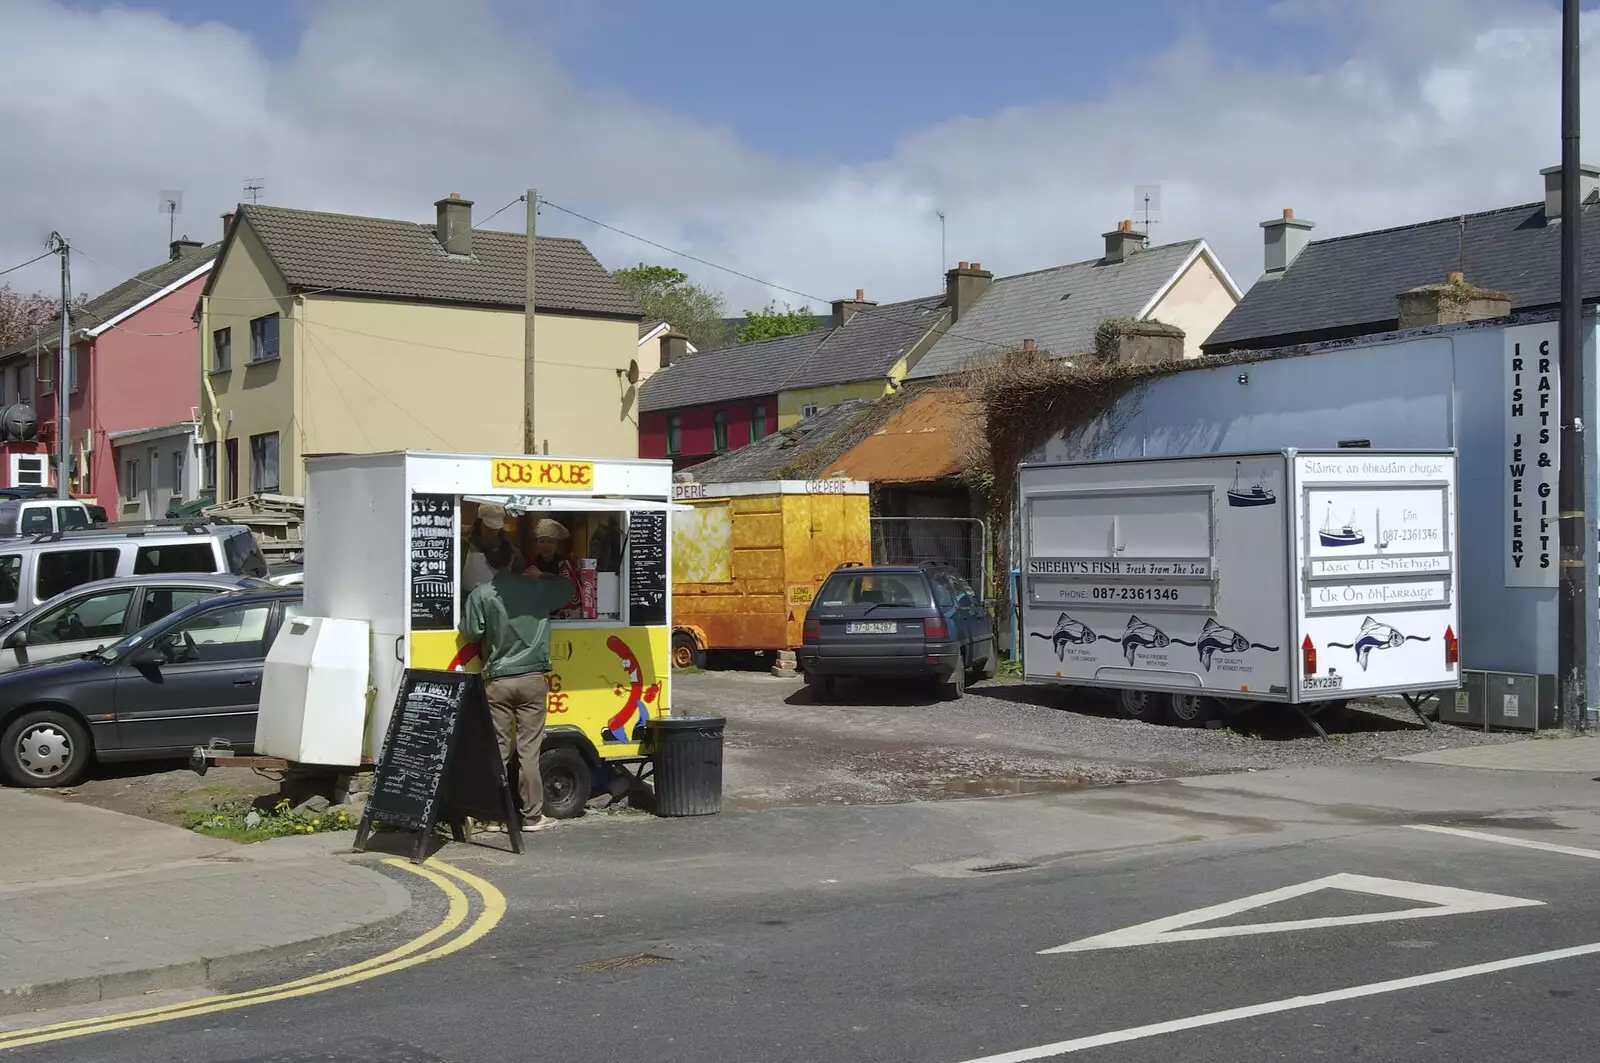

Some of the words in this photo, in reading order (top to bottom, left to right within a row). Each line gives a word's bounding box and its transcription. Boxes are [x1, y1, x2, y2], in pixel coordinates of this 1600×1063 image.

[1512, 343, 1523, 417] IRISH
[1538, 341, 1550, 444] CRAFTS
[1538, 453, 1551, 467] &
[496, 463, 532, 483] DOG
[1347, 465, 1358, 474] an
[412, 498, 437, 513] IT'S
[441, 500, 450, 511] A
[1510, 434, 1525, 568] JEWELLERY
[412, 515, 433, 526] DOG
[1538, 482, 1550, 568] GIFTS
[1382, 529, 1438, 541] 087-2361346
[412, 550, 426, 559] ALL
[428, 550, 449, 559] DOGS
[1030, 562, 1088, 574] SHEEHY'S
[1092, 562, 1120, 574] FISH
[1126, 563, 1146, 575] Fresh
[1150, 564, 1170, 575] From
[1173, 564, 1187, 575] The
[1190, 564, 1205, 575] Sea
[793, 587, 808, 595] LONG
[1060, 590, 1089, 599] PHONE:
[1092, 587, 1179, 600] 087-2361346
[790, 594, 812, 602] VEHICLE
[415, 682, 430, 693] HOT
[1303, 677, 1342, 689] 05KY2367
